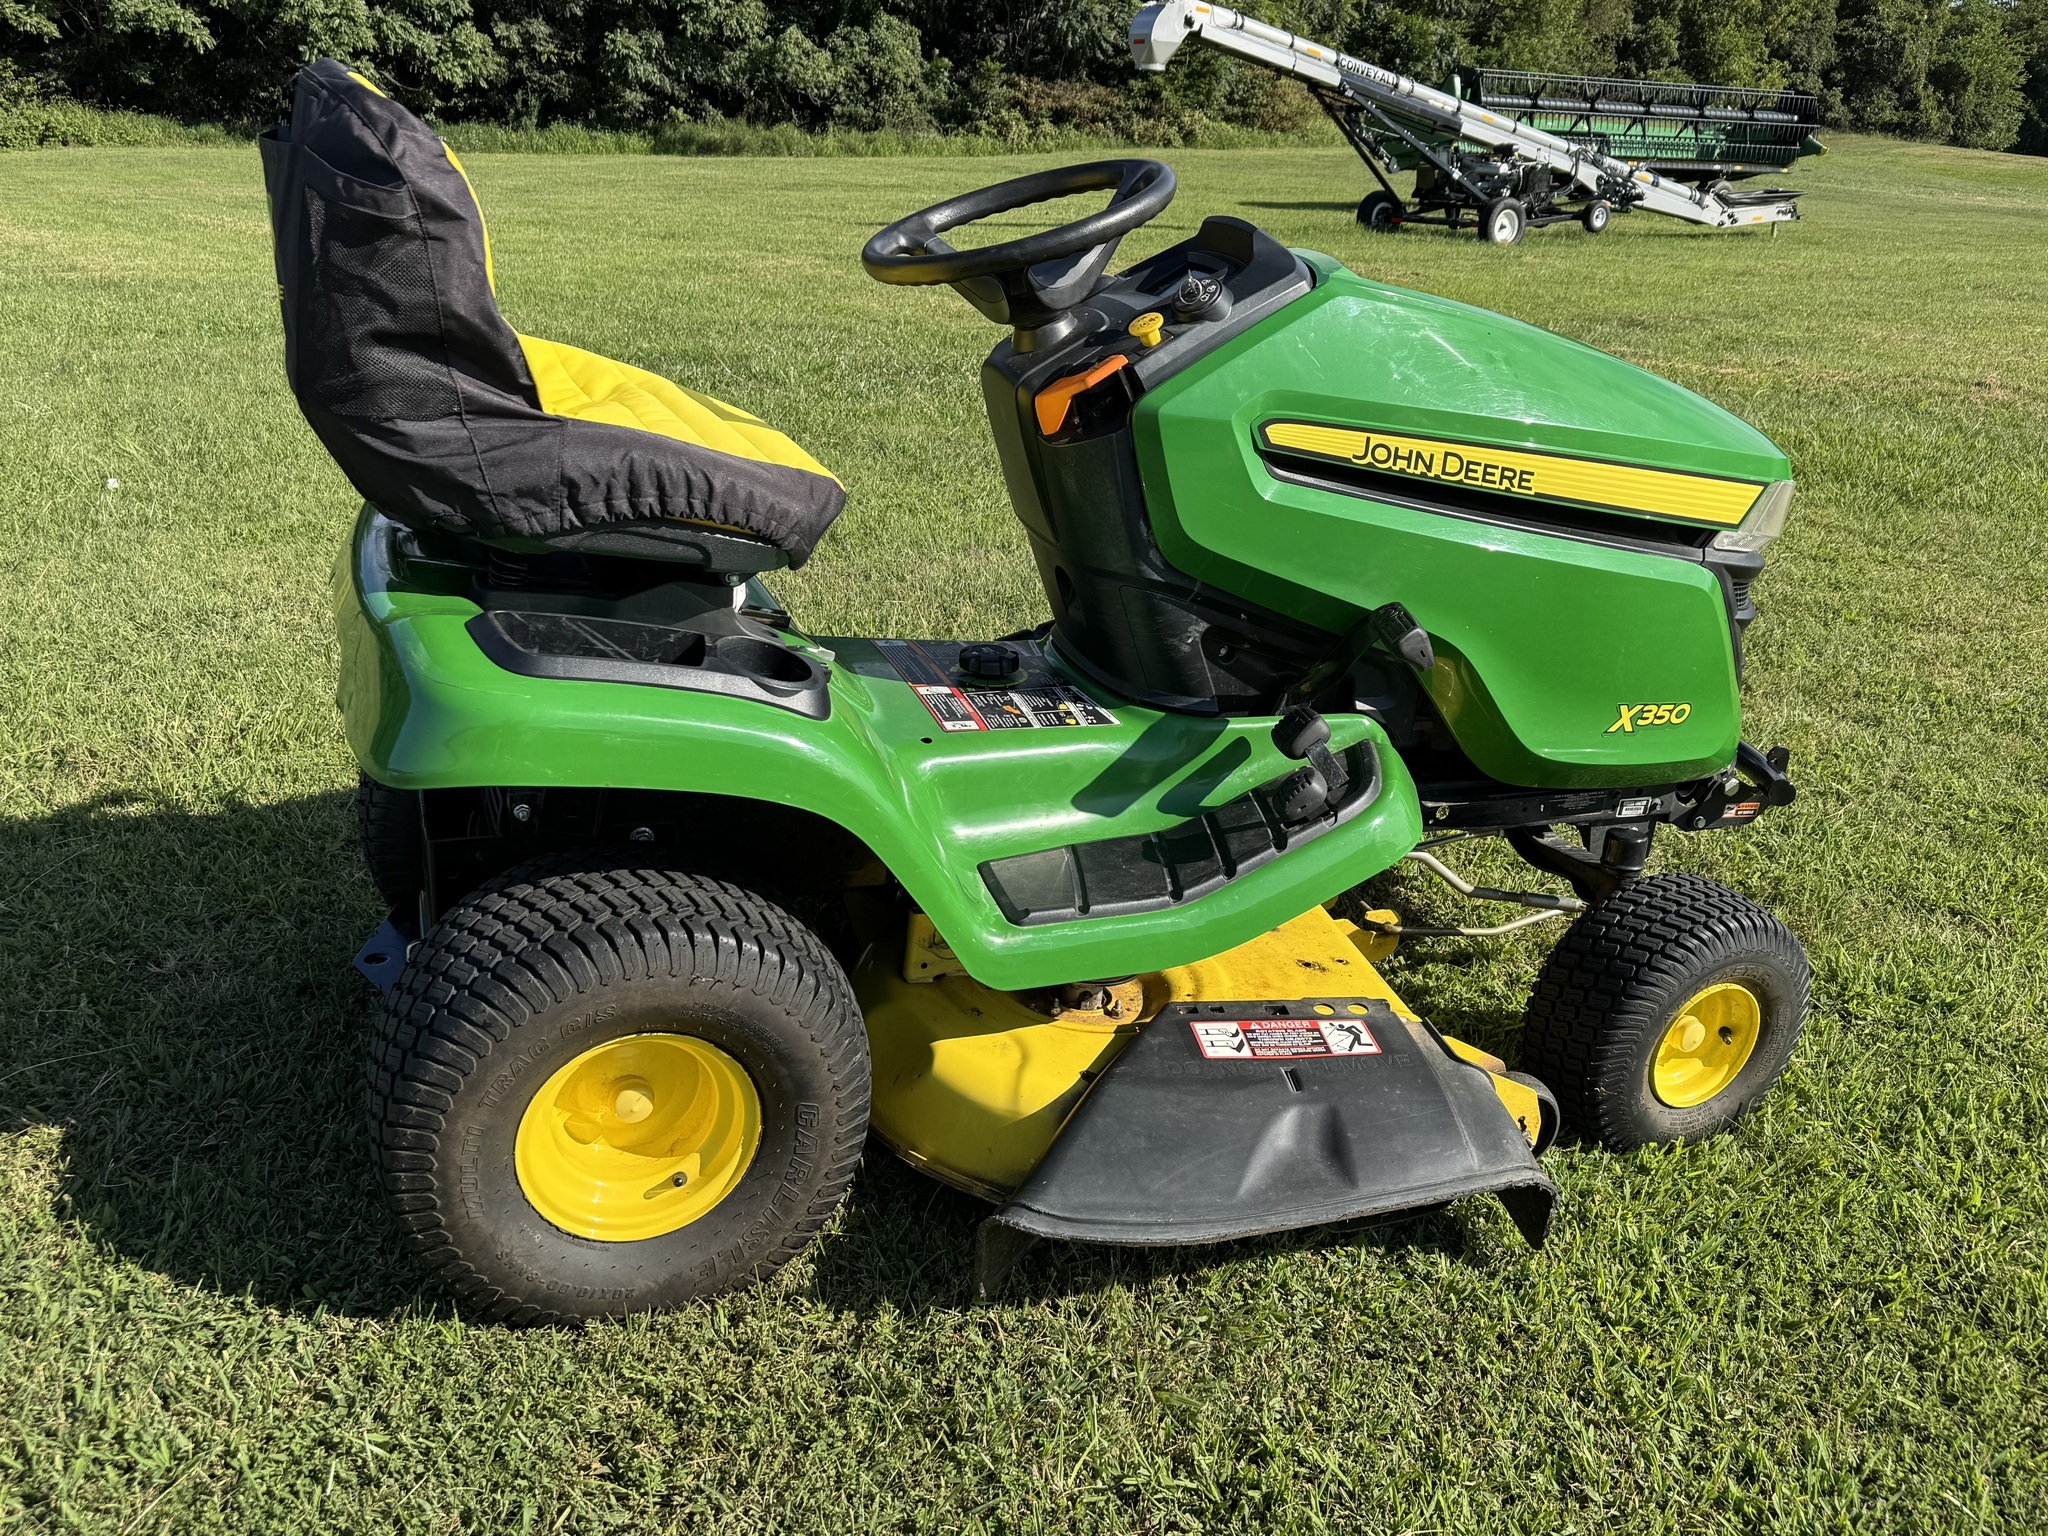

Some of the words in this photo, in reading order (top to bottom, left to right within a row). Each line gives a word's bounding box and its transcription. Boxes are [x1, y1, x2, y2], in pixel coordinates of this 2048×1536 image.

[1351, 435, 1435, 474] JOHN
[1440, 450, 1536, 492] DEERE
[1602, 702, 1692, 734] X350
[1262, 1021, 1312, 1029] DANGER
[459, 1124, 486, 1220] MULTI
[478, 1037, 550, 1109] TRAC
[690, 1102, 820, 1288] CARLISLE
